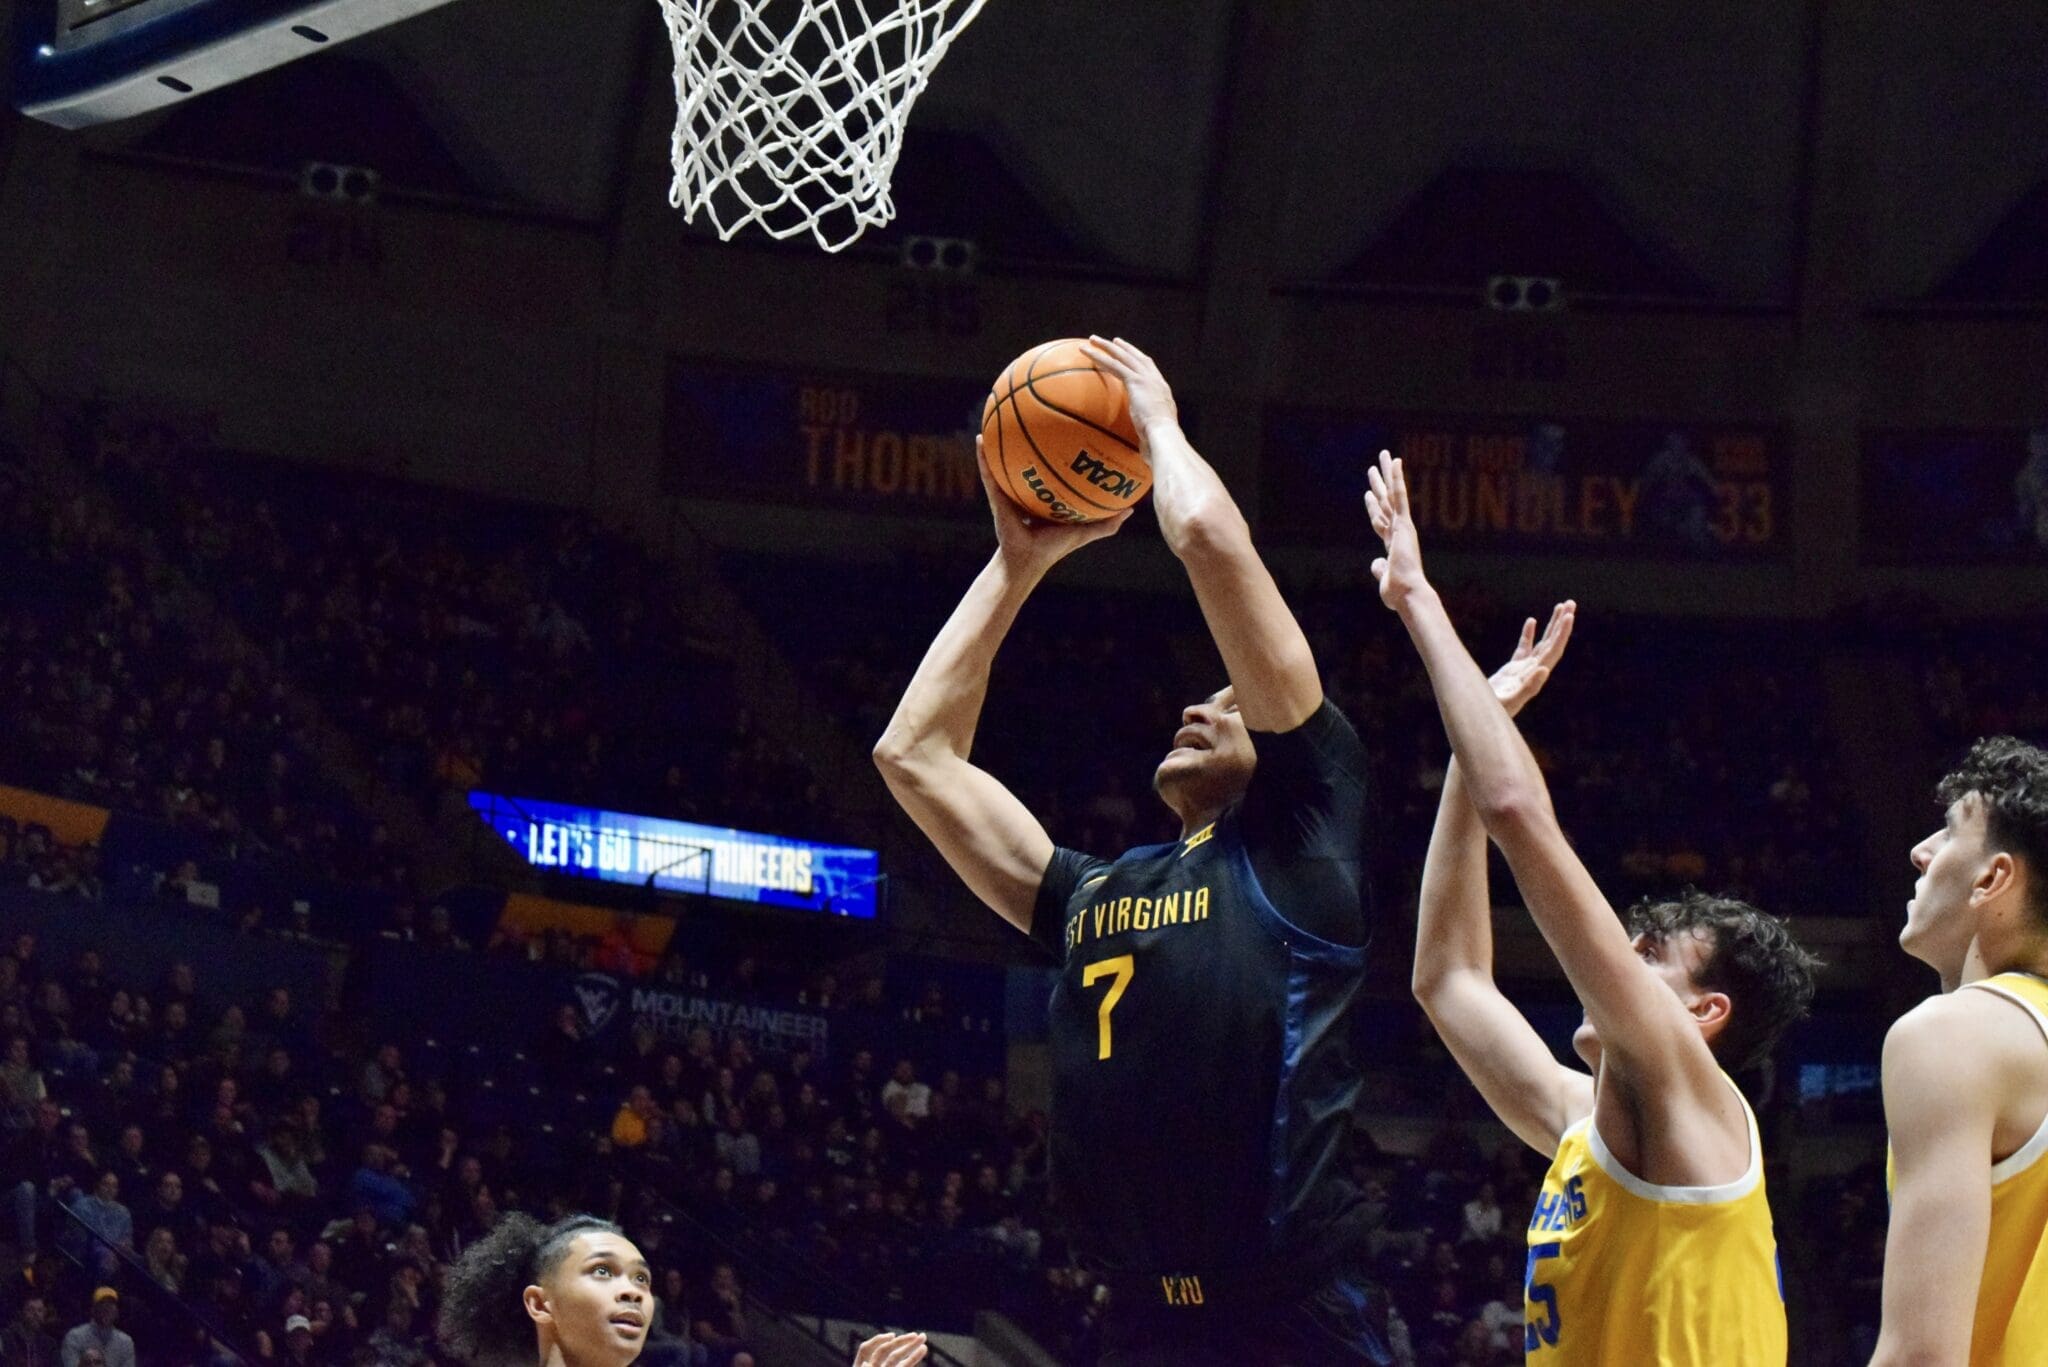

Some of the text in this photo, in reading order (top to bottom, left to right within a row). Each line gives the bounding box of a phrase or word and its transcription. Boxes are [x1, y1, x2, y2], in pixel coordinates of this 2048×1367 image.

[1070, 450, 1141, 499] NCAA
[1709, 480, 1772, 543] 33
[528, 822, 592, 869] LET'S
[599, 826, 631, 872] GO
[1094, 886, 1210, 940] VIRGINIA
[632, 987, 828, 1038] MOUNTAINEER
[1082, 953, 1135, 1061] 7
[1525, 1241, 1562, 1353] 5
